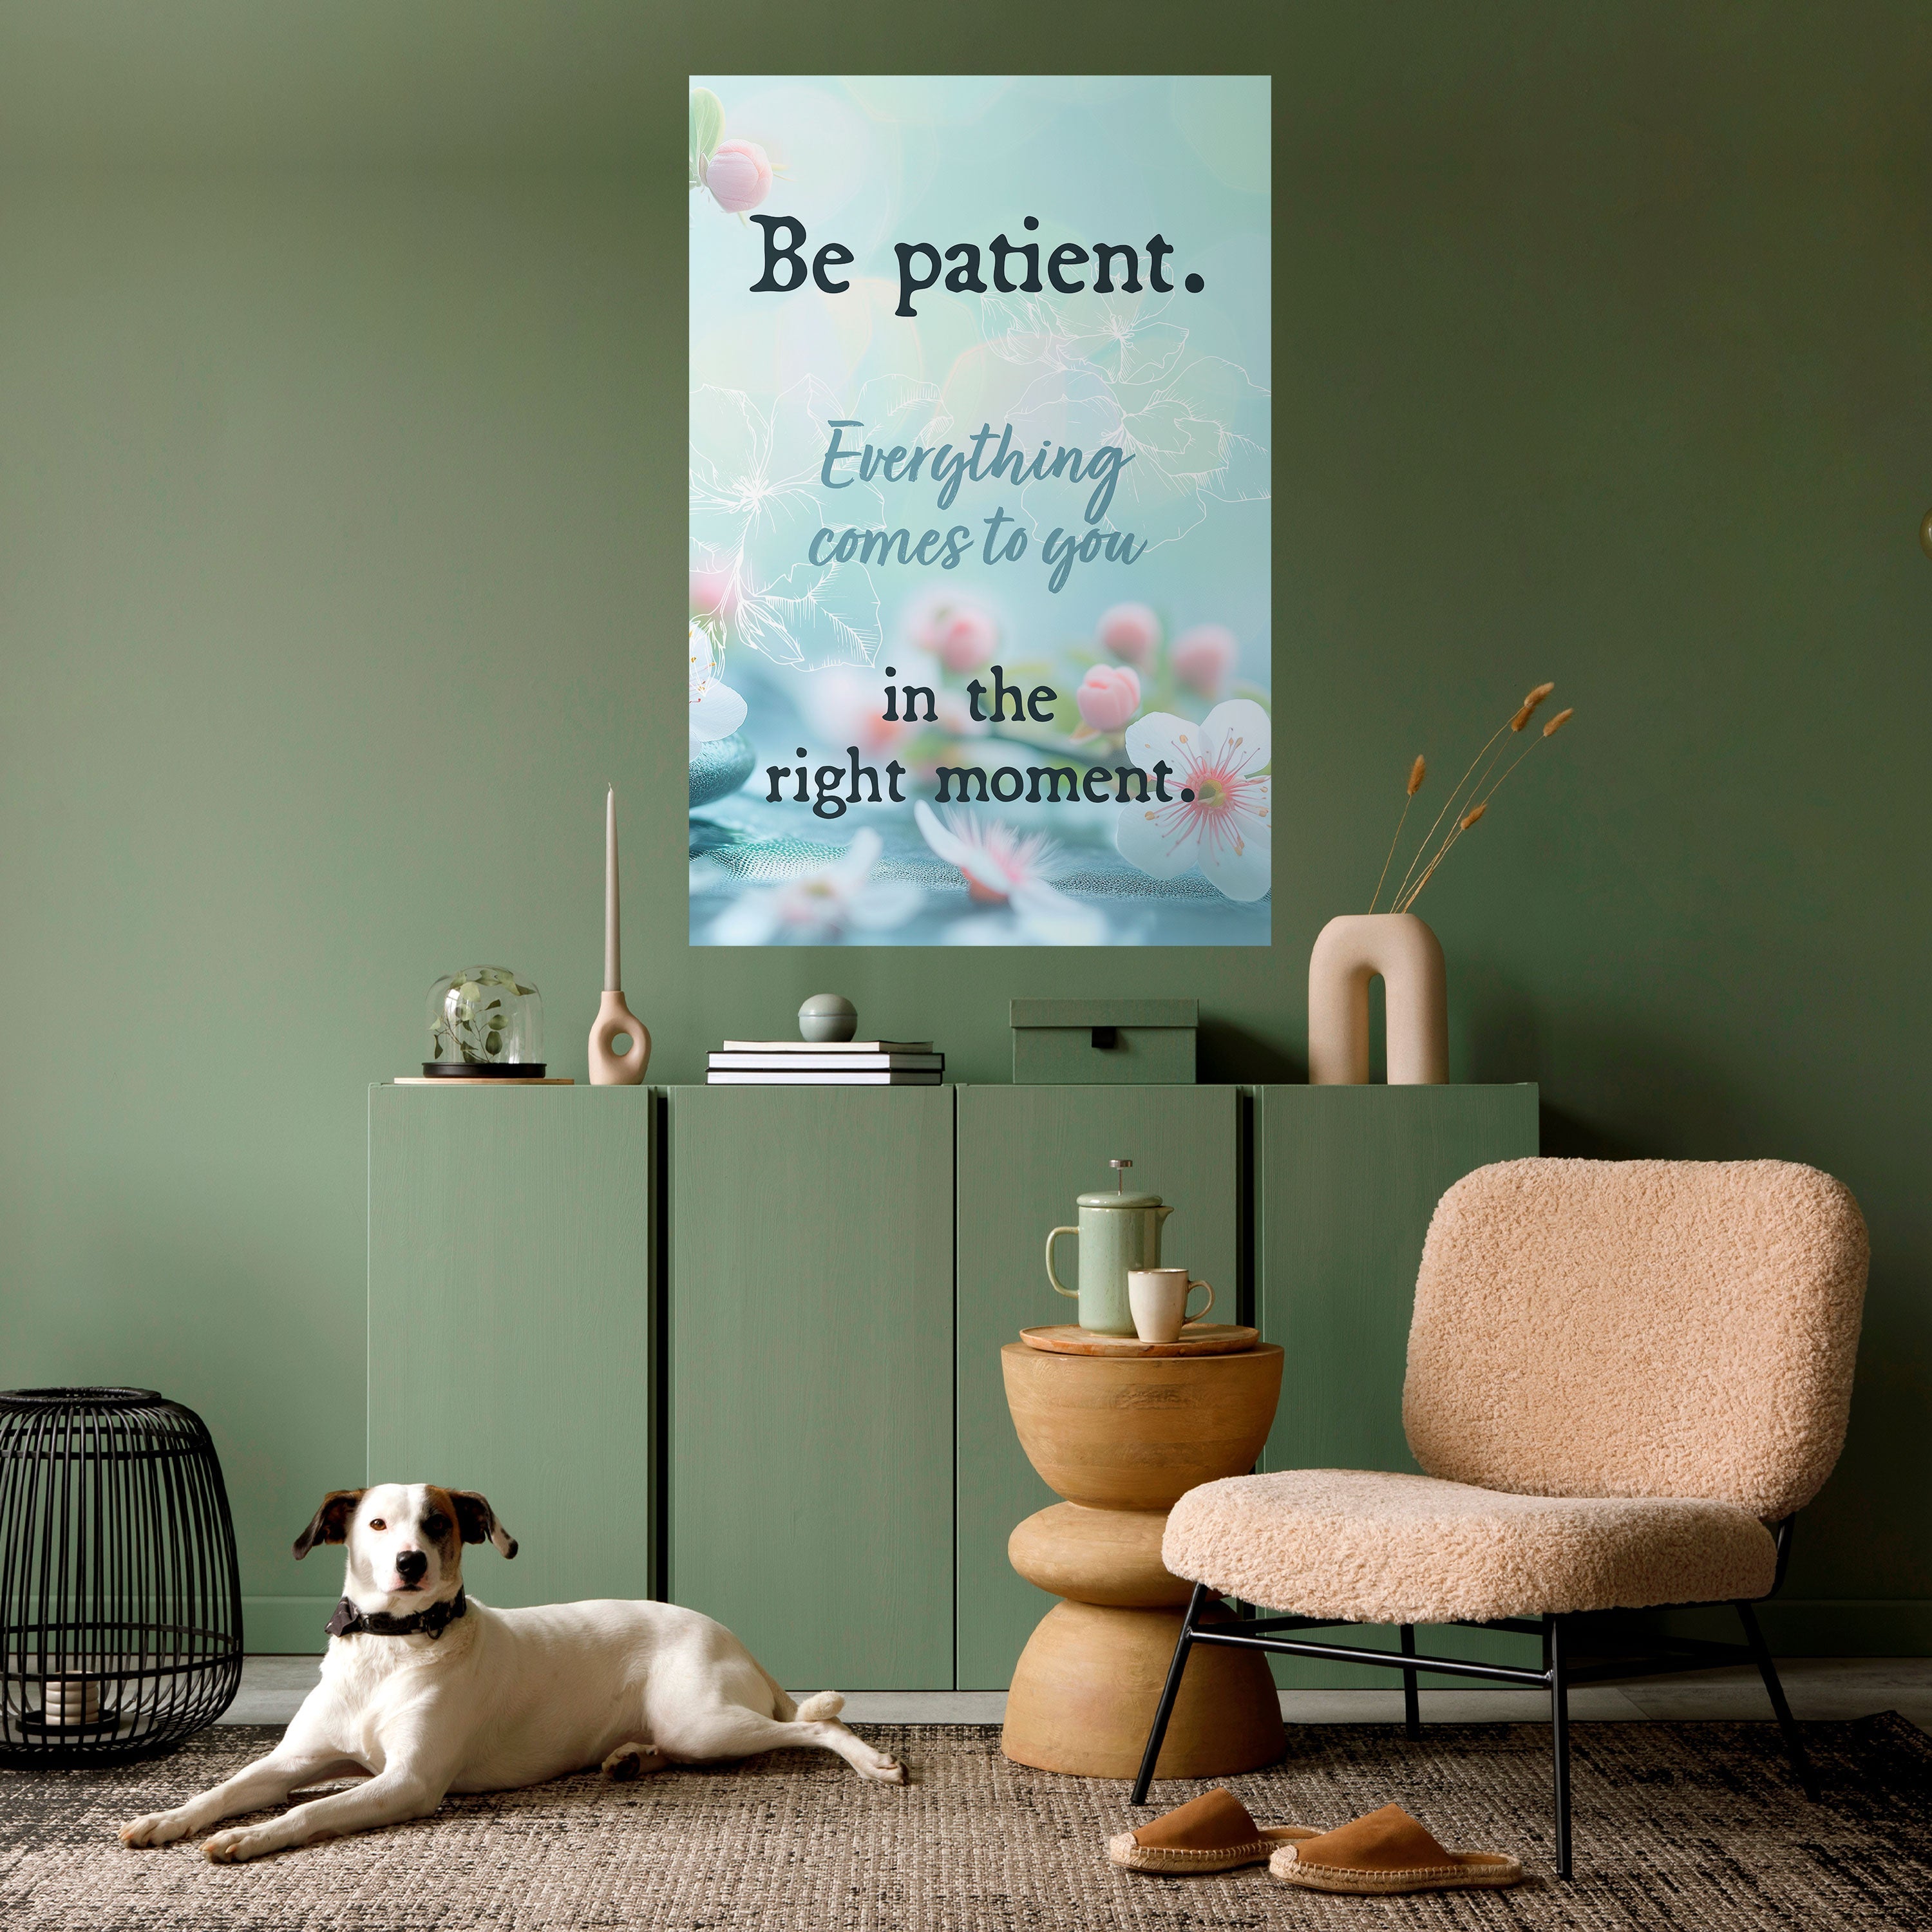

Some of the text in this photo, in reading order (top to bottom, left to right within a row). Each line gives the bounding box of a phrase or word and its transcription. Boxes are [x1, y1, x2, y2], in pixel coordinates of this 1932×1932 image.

[749, 214, 1205, 317] Be patient.
[820, 420, 1136, 522] Everything
[808, 506, 1148, 594] comes to you
[882, 665, 1057, 723] in the
[766, 746, 1195, 819] right moment.
